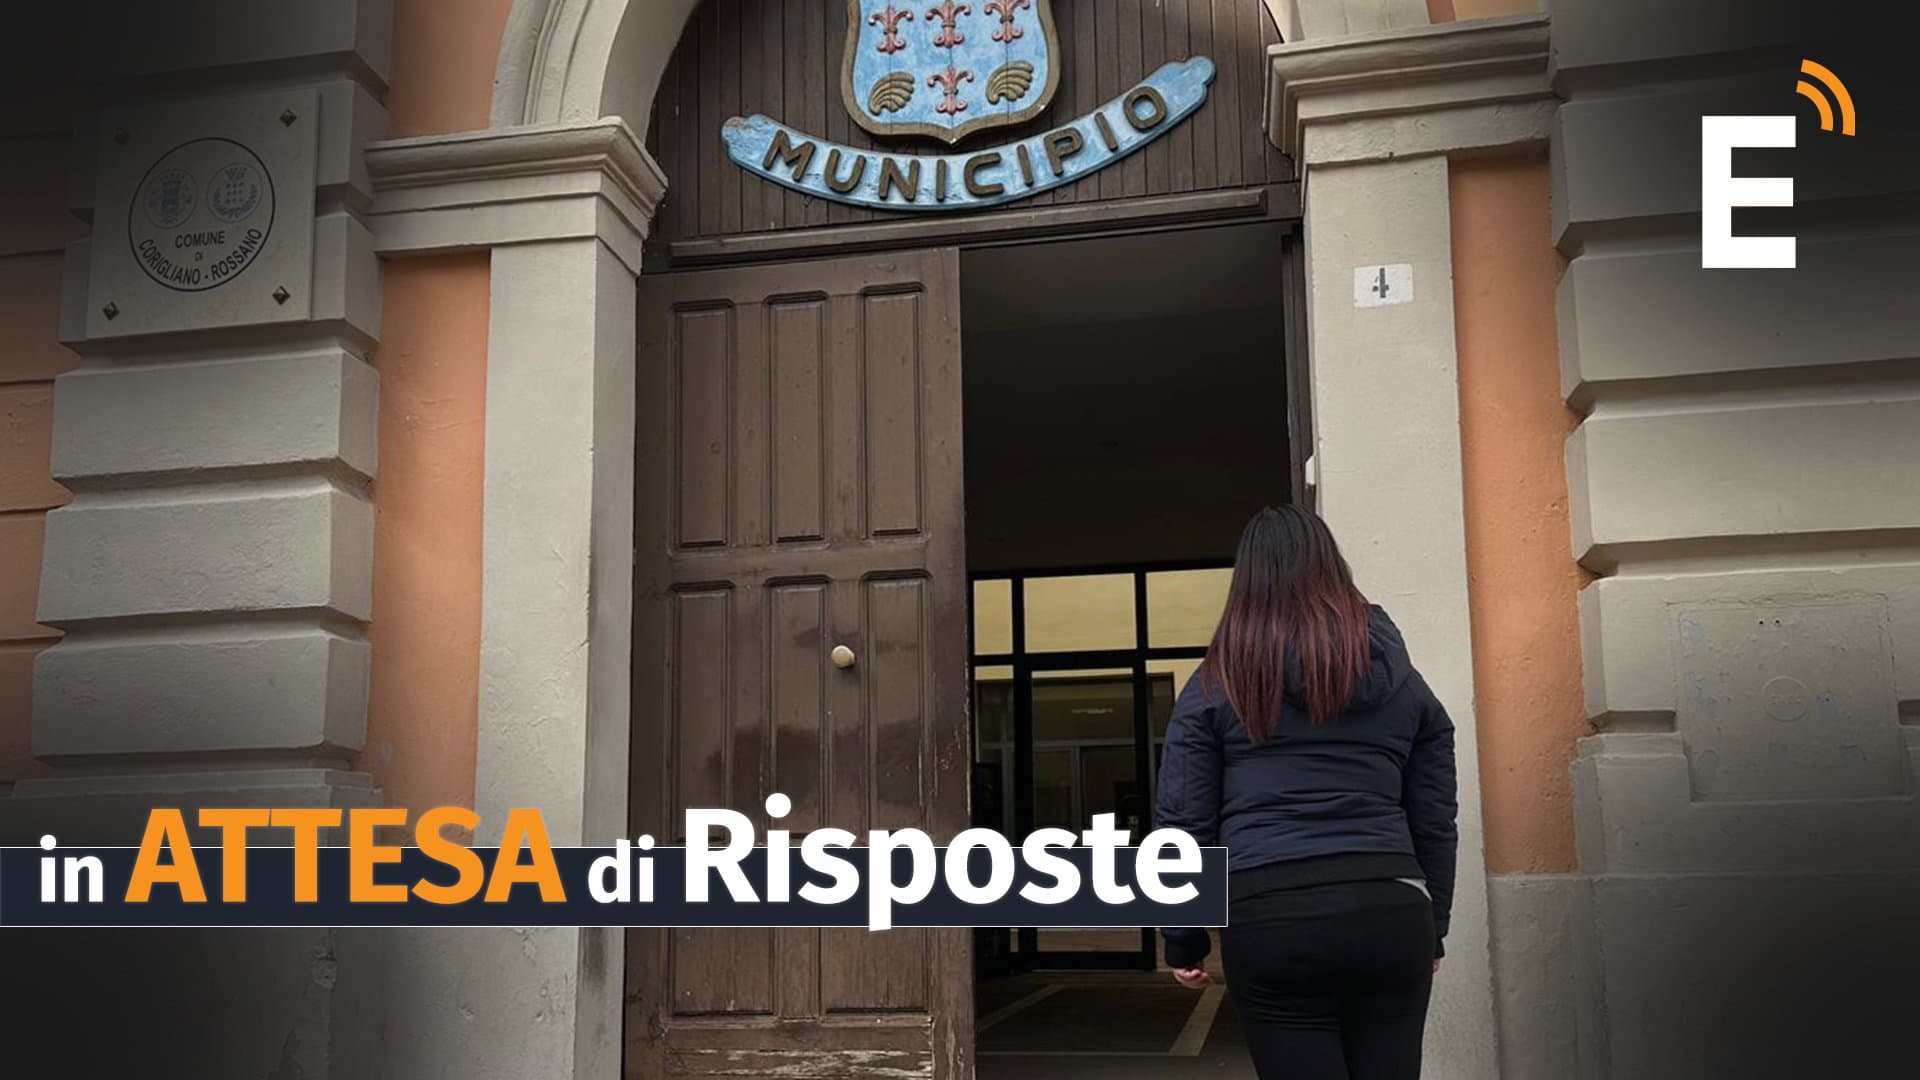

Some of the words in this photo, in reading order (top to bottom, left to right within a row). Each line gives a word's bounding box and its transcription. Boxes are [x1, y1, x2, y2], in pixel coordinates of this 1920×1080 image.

[763, 86, 1167, 201] MUNICIPIO
[175, 231, 225, 249] COMUNE
[139, 239, 200, 285] CORIGLIANO
[211, 228, 263, 281] ROSSANO
[195, 251, 204, 262] DI
[1372, 267, 1389, 299] 4
